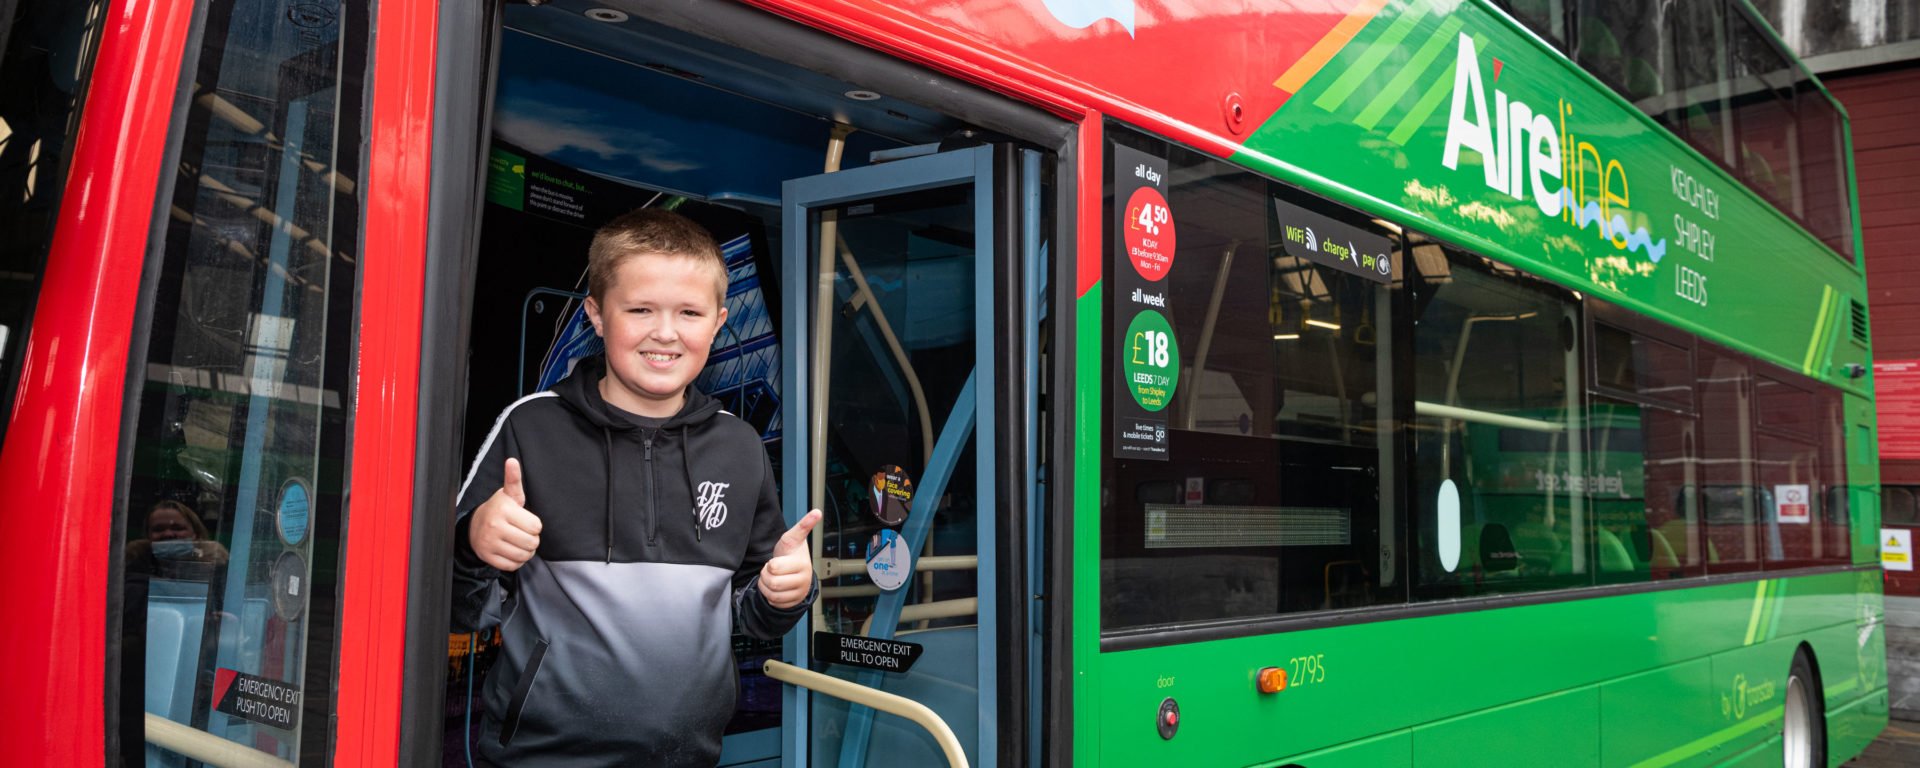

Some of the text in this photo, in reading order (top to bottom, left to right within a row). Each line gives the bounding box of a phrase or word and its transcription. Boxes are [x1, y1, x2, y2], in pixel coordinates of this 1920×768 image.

[1442, 32, 1629, 249] Aireline
[1135, 164, 1161, 186] all day
[1674, 213, 1715, 263] SHIPLEY
[1138, 247, 1152, 259] before
[1286, 225, 1376, 271] WiFi charge pay
[1140, 260, 1151, 269] Mon
[1676, 263, 1708, 307] LEEDS
[1132, 288, 1165, 307] all week
[1132, 330, 1169, 368] £18
[1157, 375, 1170, 386] DAY
[1138, 385, 1166, 398] from Shipley
[1148, 397, 1162, 406] Leeds
[887, 480, 898, 489] face
[887, 487, 911, 499] covering
[873, 562, 889, 571] one
[840, 637, 912, 656] EMERGENCY EXIT
[840, 650, 899, 668] PULL TO OPEN
[1290, 654, 1325, 687] 2795
[238, 678, 285, 702] EMERGENCY
[1157, 675, 1175, 689] door
[236, 696, 291, 724] PUSH TO OPEN
